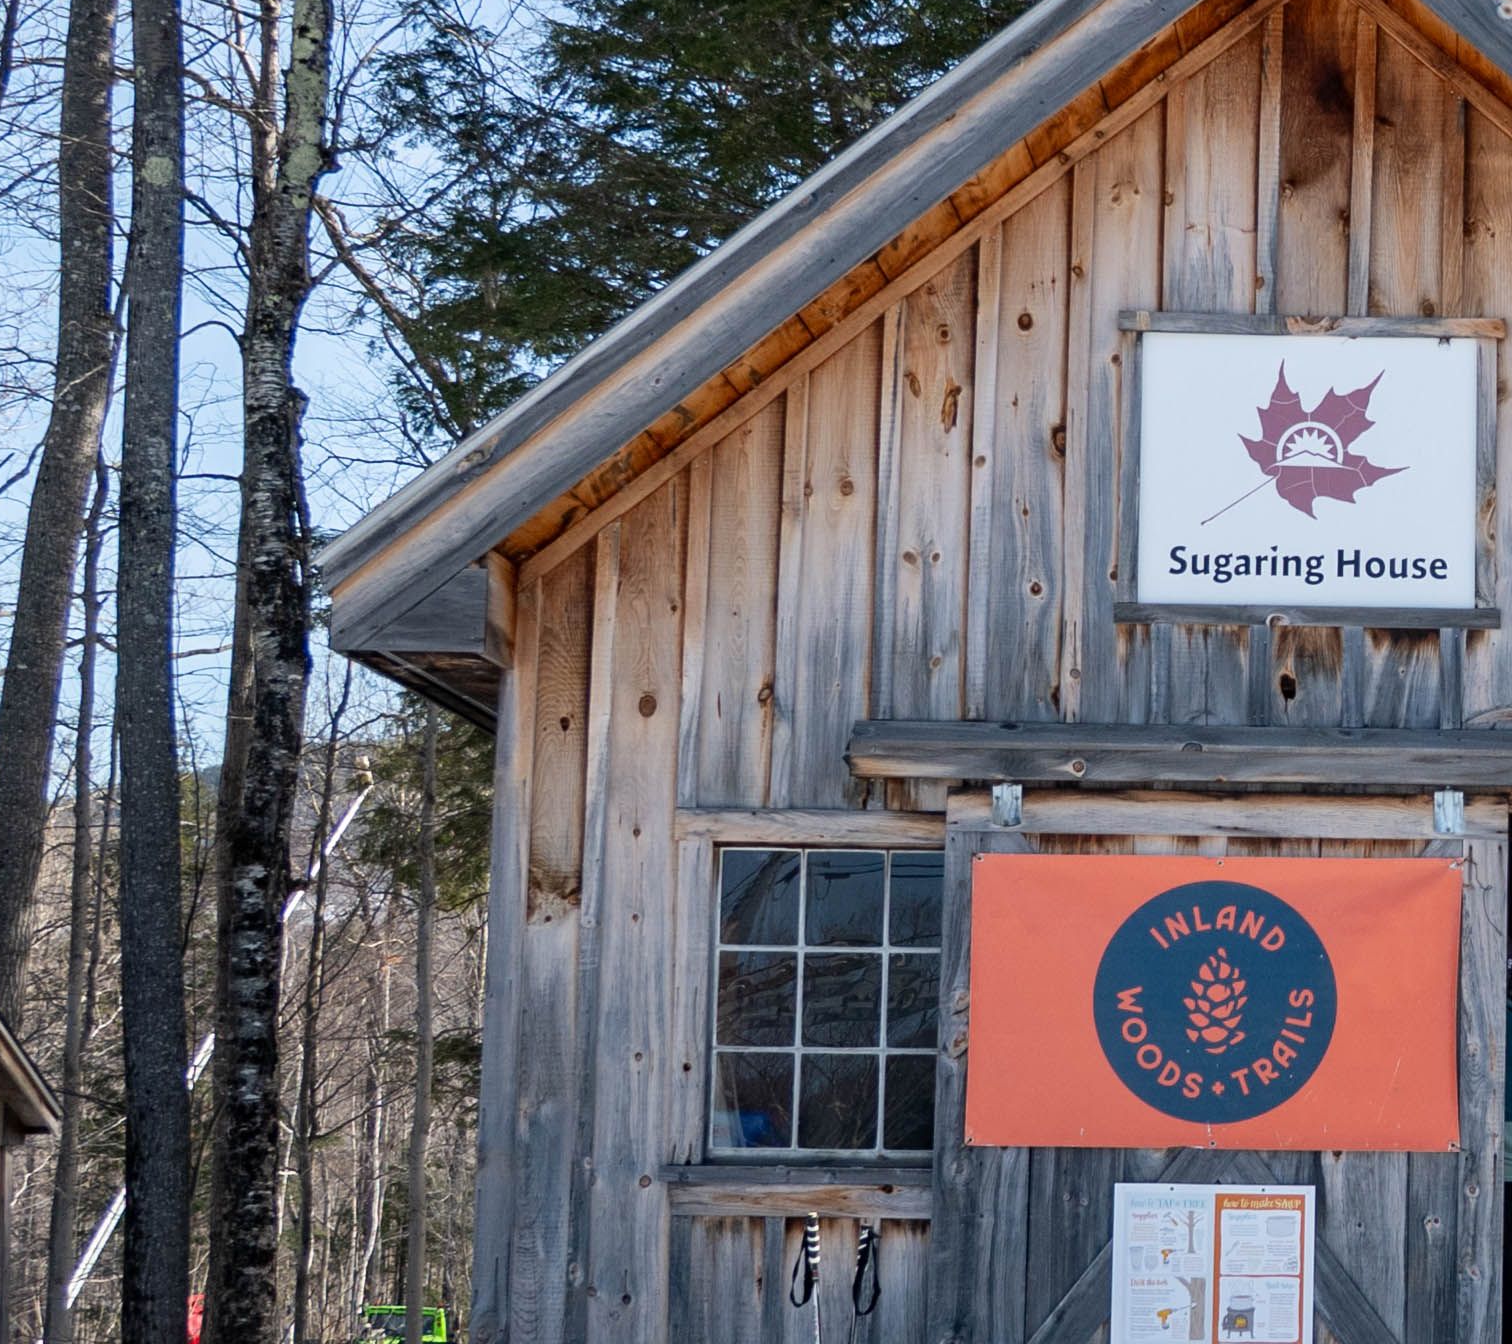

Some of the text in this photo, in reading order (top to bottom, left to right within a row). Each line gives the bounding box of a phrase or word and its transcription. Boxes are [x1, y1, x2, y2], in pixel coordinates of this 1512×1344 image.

[1169, 545, 1448, 585] Sugaring House
[1149, 904, 1287, 952] INLAND
[1116, 985, 1205, 1099] WOODS
[1231, 987, 1315, 1097] TRAILS
